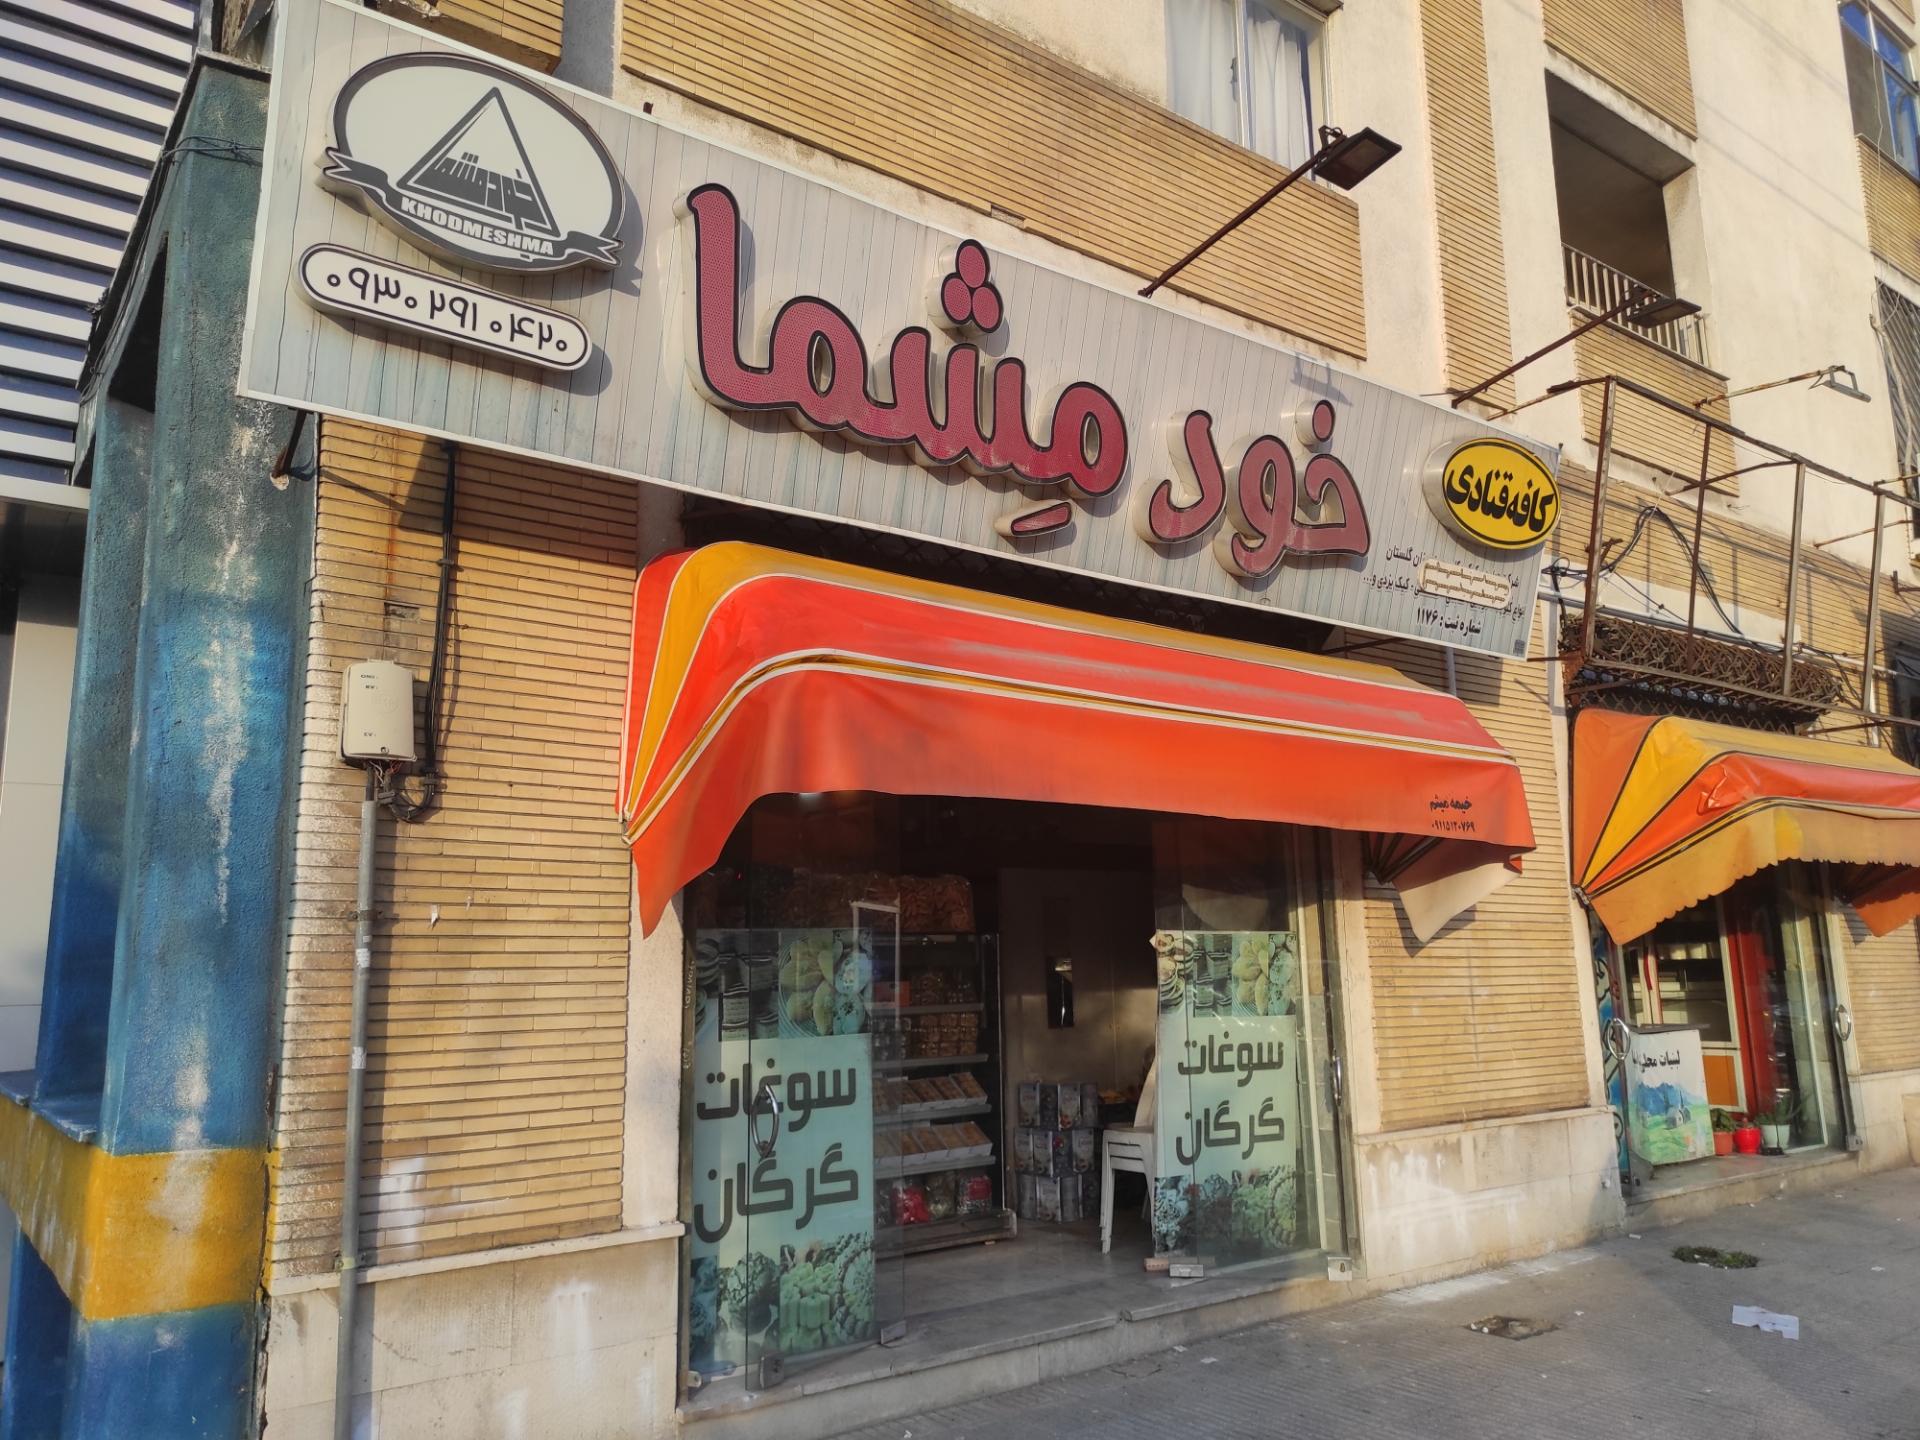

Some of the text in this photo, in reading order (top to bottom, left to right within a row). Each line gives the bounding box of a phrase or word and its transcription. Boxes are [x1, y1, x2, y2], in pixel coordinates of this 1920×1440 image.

[400, 196, 554, 256] KHODMESHMA
[326, 267, 568, 351] ۰۹۳۰ ۲۹۱ ۰۴۲۰
[1446, 465, 1555, 533] کافه قنادی
[1459, 618, 1482, 636] شماره
[1177, 1031, 1285, 1088] سوغات
[696, 1057, 857, 1133] سوغات
[1175, 1096, 1286, 1167] گرگان
[693, 1142, 860, 1244] گرگان
